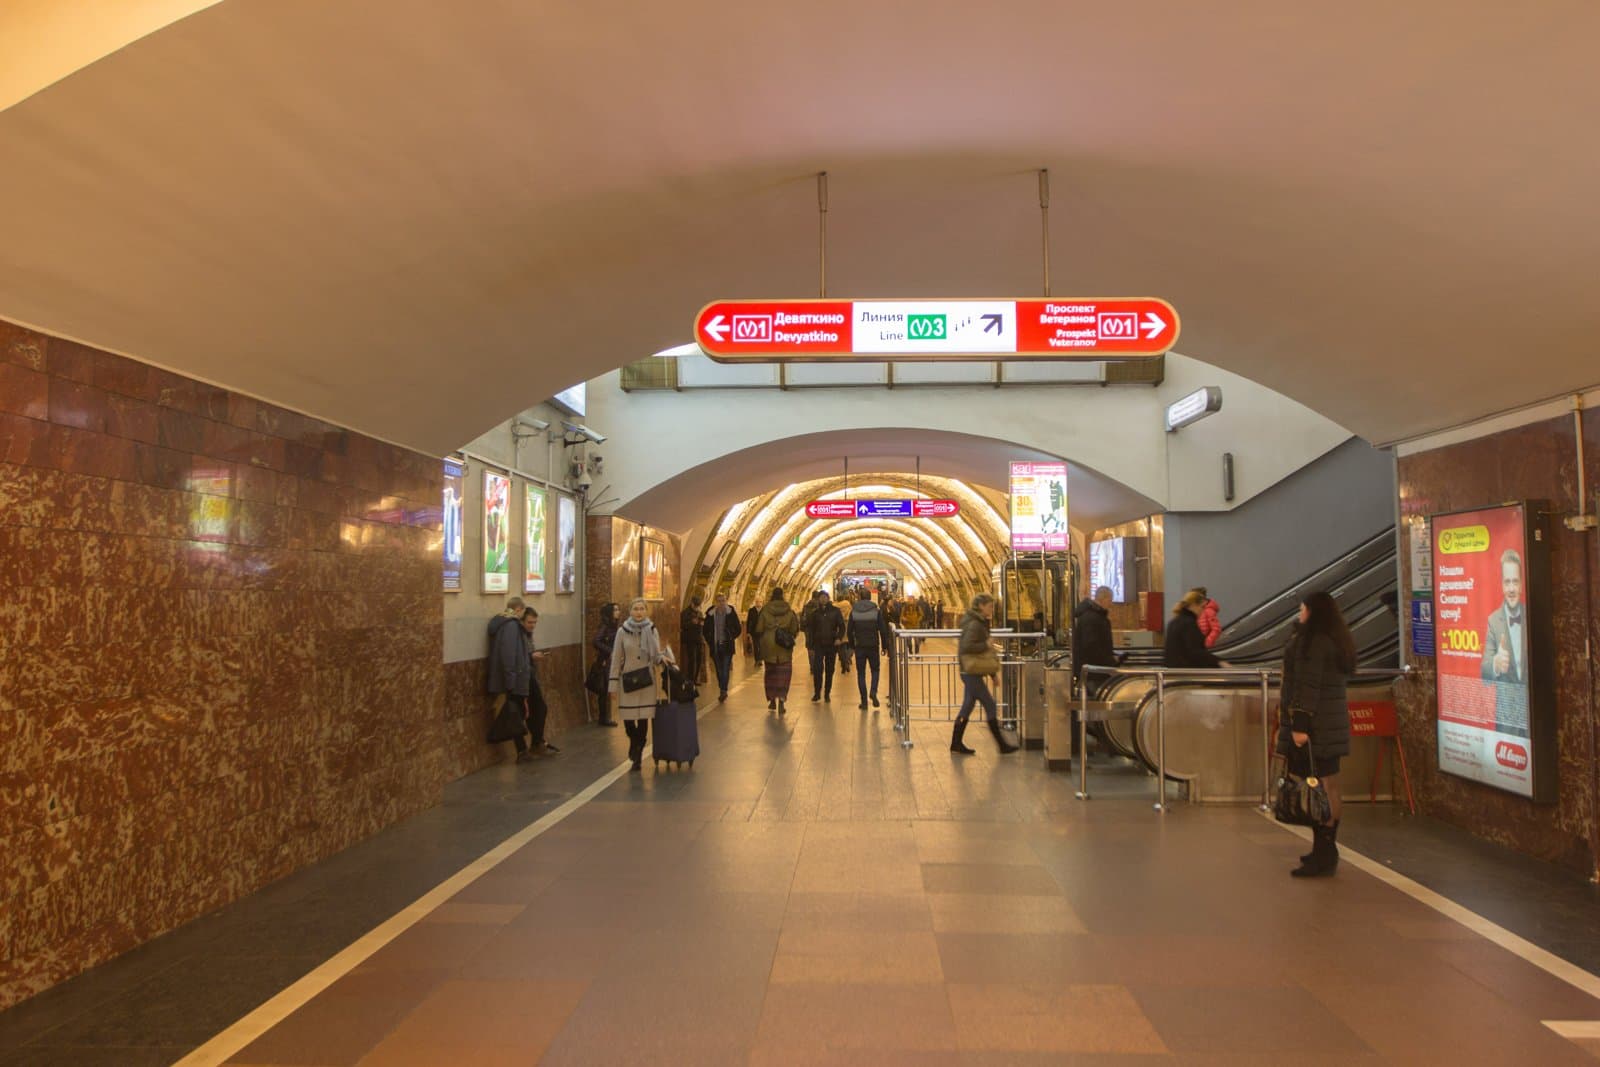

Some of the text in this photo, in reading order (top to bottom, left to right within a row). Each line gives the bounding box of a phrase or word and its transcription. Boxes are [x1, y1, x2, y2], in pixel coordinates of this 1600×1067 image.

[1045, 304, 1096, 315] Проспект
[774, 311, 845, 327] Девяткино
[861, 312, 904, 322] Линия
[1040, 314, 1096, 325] Ветеранов
[774, 331, 838, 345] Devyatkino
[880, 331, 904, 341] Line
[1056, 328, 1097, 340] Prospekt
[1049, 338, 1097, 347] Veteranov
